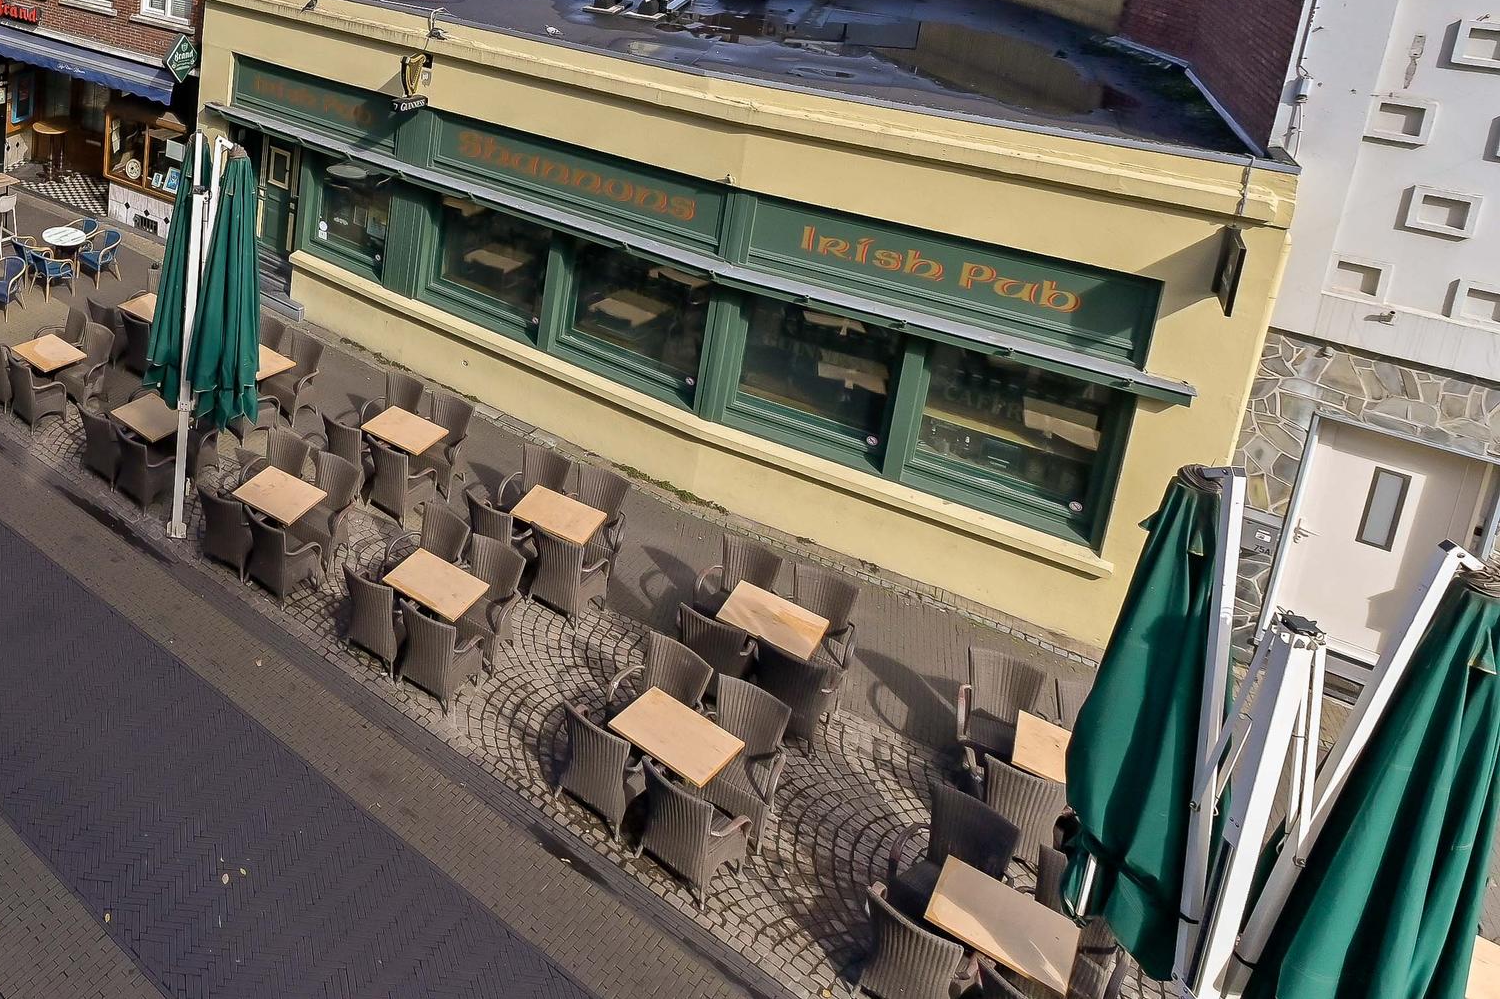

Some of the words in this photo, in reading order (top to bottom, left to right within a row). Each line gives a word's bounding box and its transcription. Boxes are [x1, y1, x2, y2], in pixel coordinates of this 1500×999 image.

[174, 50, 194, 62] Brand
[458, 131, 697, 221] Shannons
[800, 225, 944, 281] Irish
[959, 261, 1082, 313] Pub
[1254, 544, 1270, 556] 75A
